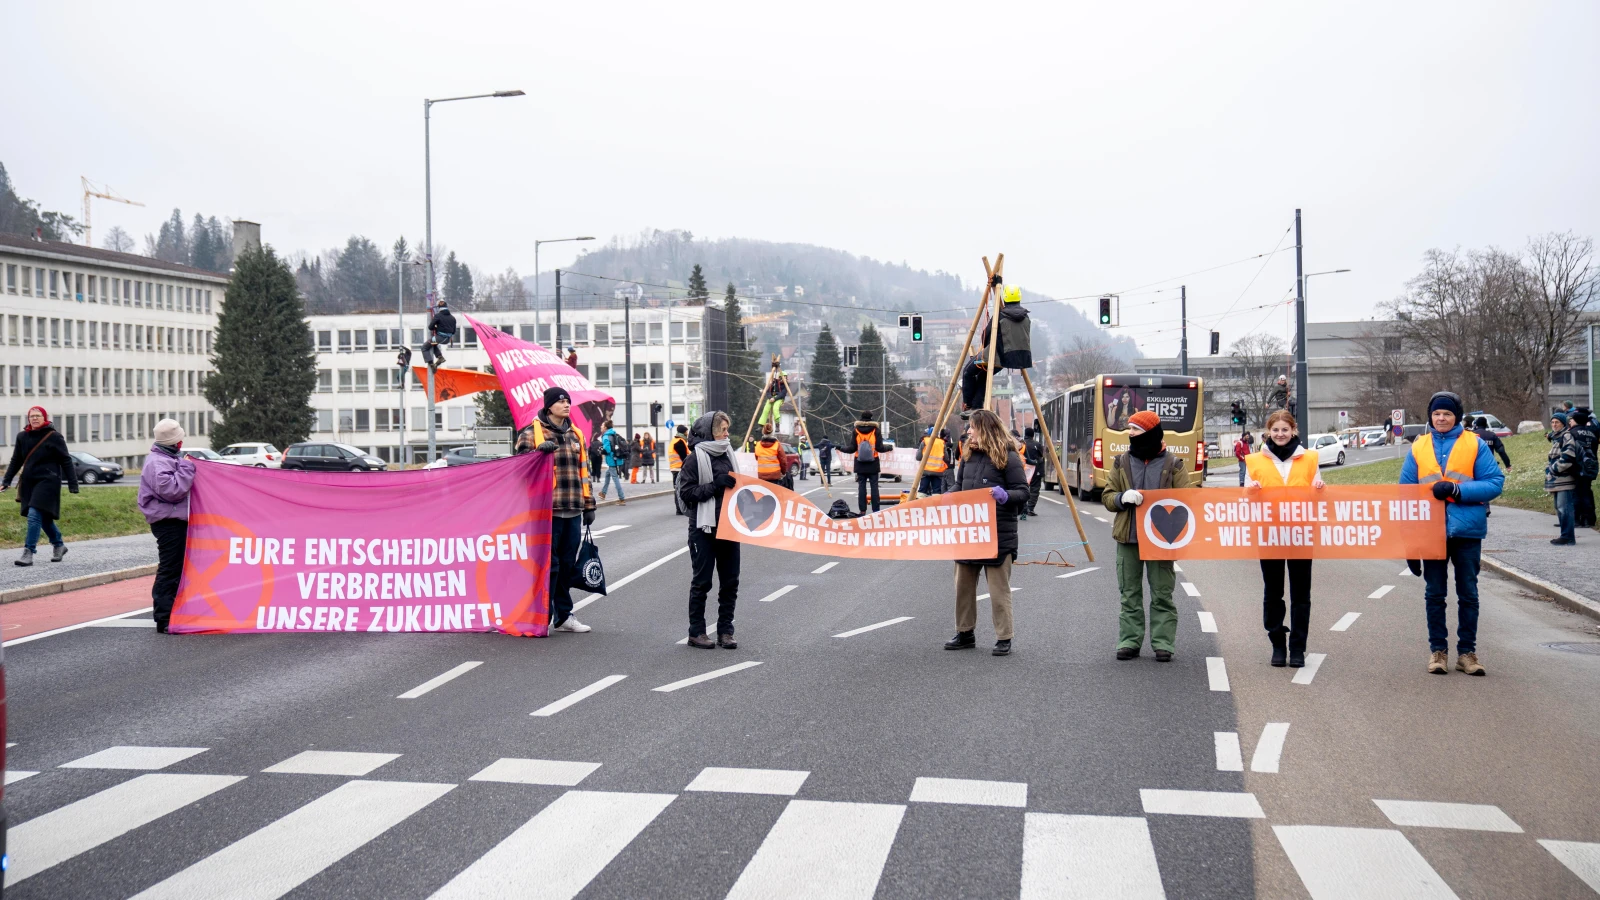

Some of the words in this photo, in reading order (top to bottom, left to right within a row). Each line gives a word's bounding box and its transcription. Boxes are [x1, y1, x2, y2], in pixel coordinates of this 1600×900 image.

[495, 349, 530, 373] WER
[510, 377, 550, 407] WIRD
[1146, 403, 1188, 416] FIRST
[857, 503, 989, 530] GENERATION
[1203, 498, 1272, 523] SCHÖNE
[1279, 501, 1328, 522] HEILE
[1334, 500, 1382, 521] WELT
[1389, 499, 1431, 521] HIER
[782, 521, 819, 542] VOR
[824, 530, 859, 546] DEN
[864, 526, 991, 547] KIPPPUNKTEN
[1218, 526, 1251, 547] WIE
[1257, 526, 1314, 547] LANGE
[1321, 525, 1382, 546] NOCH?
[228, 537, 296, 565] EURE
[304, 533, 529, 566] ENTSCHEIDUNGEN
[296, 570, 467, 600] VERBRENNEN
[256, 606, 360, 631] UNSERE
[366, 603, 503, 632] ZUKUNFT!
